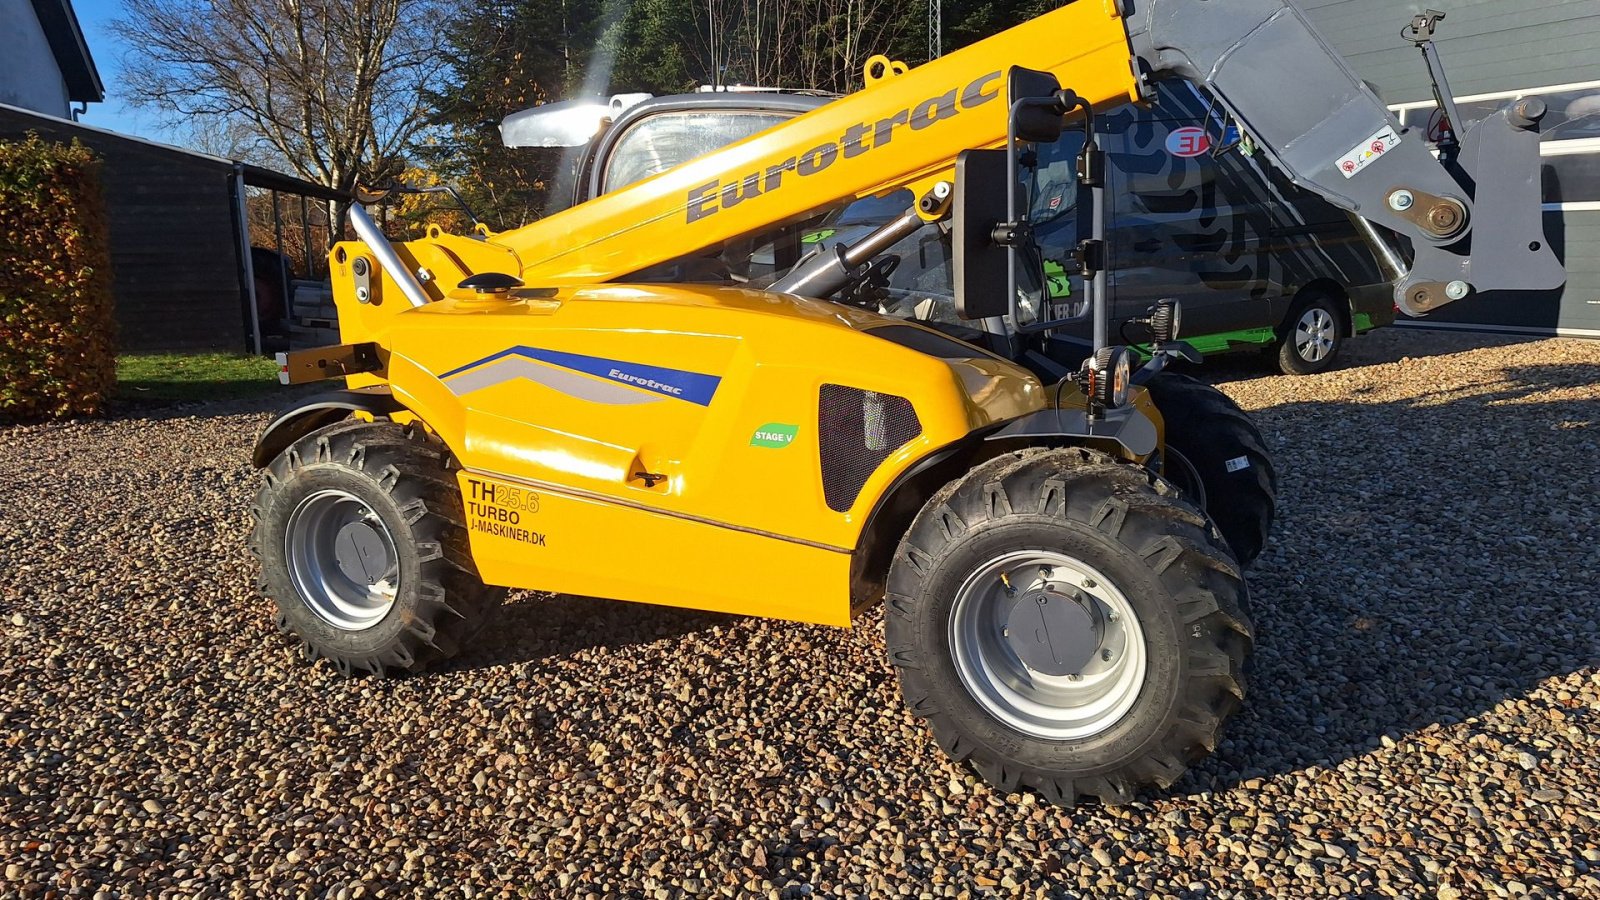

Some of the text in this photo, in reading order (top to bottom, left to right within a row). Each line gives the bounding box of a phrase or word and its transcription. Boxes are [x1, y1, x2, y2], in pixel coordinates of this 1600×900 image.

[686, 70, 1002, 225] Eurotrac
[607, 368, 683, 395] Eurotrac
[755, 431, 793, 442] STAGE V
[468, 479, 540, 514] TH25.6
[467, 501, 520, 525] TURBO
[470, 518, 546, 547] J-MASKINER.DK
